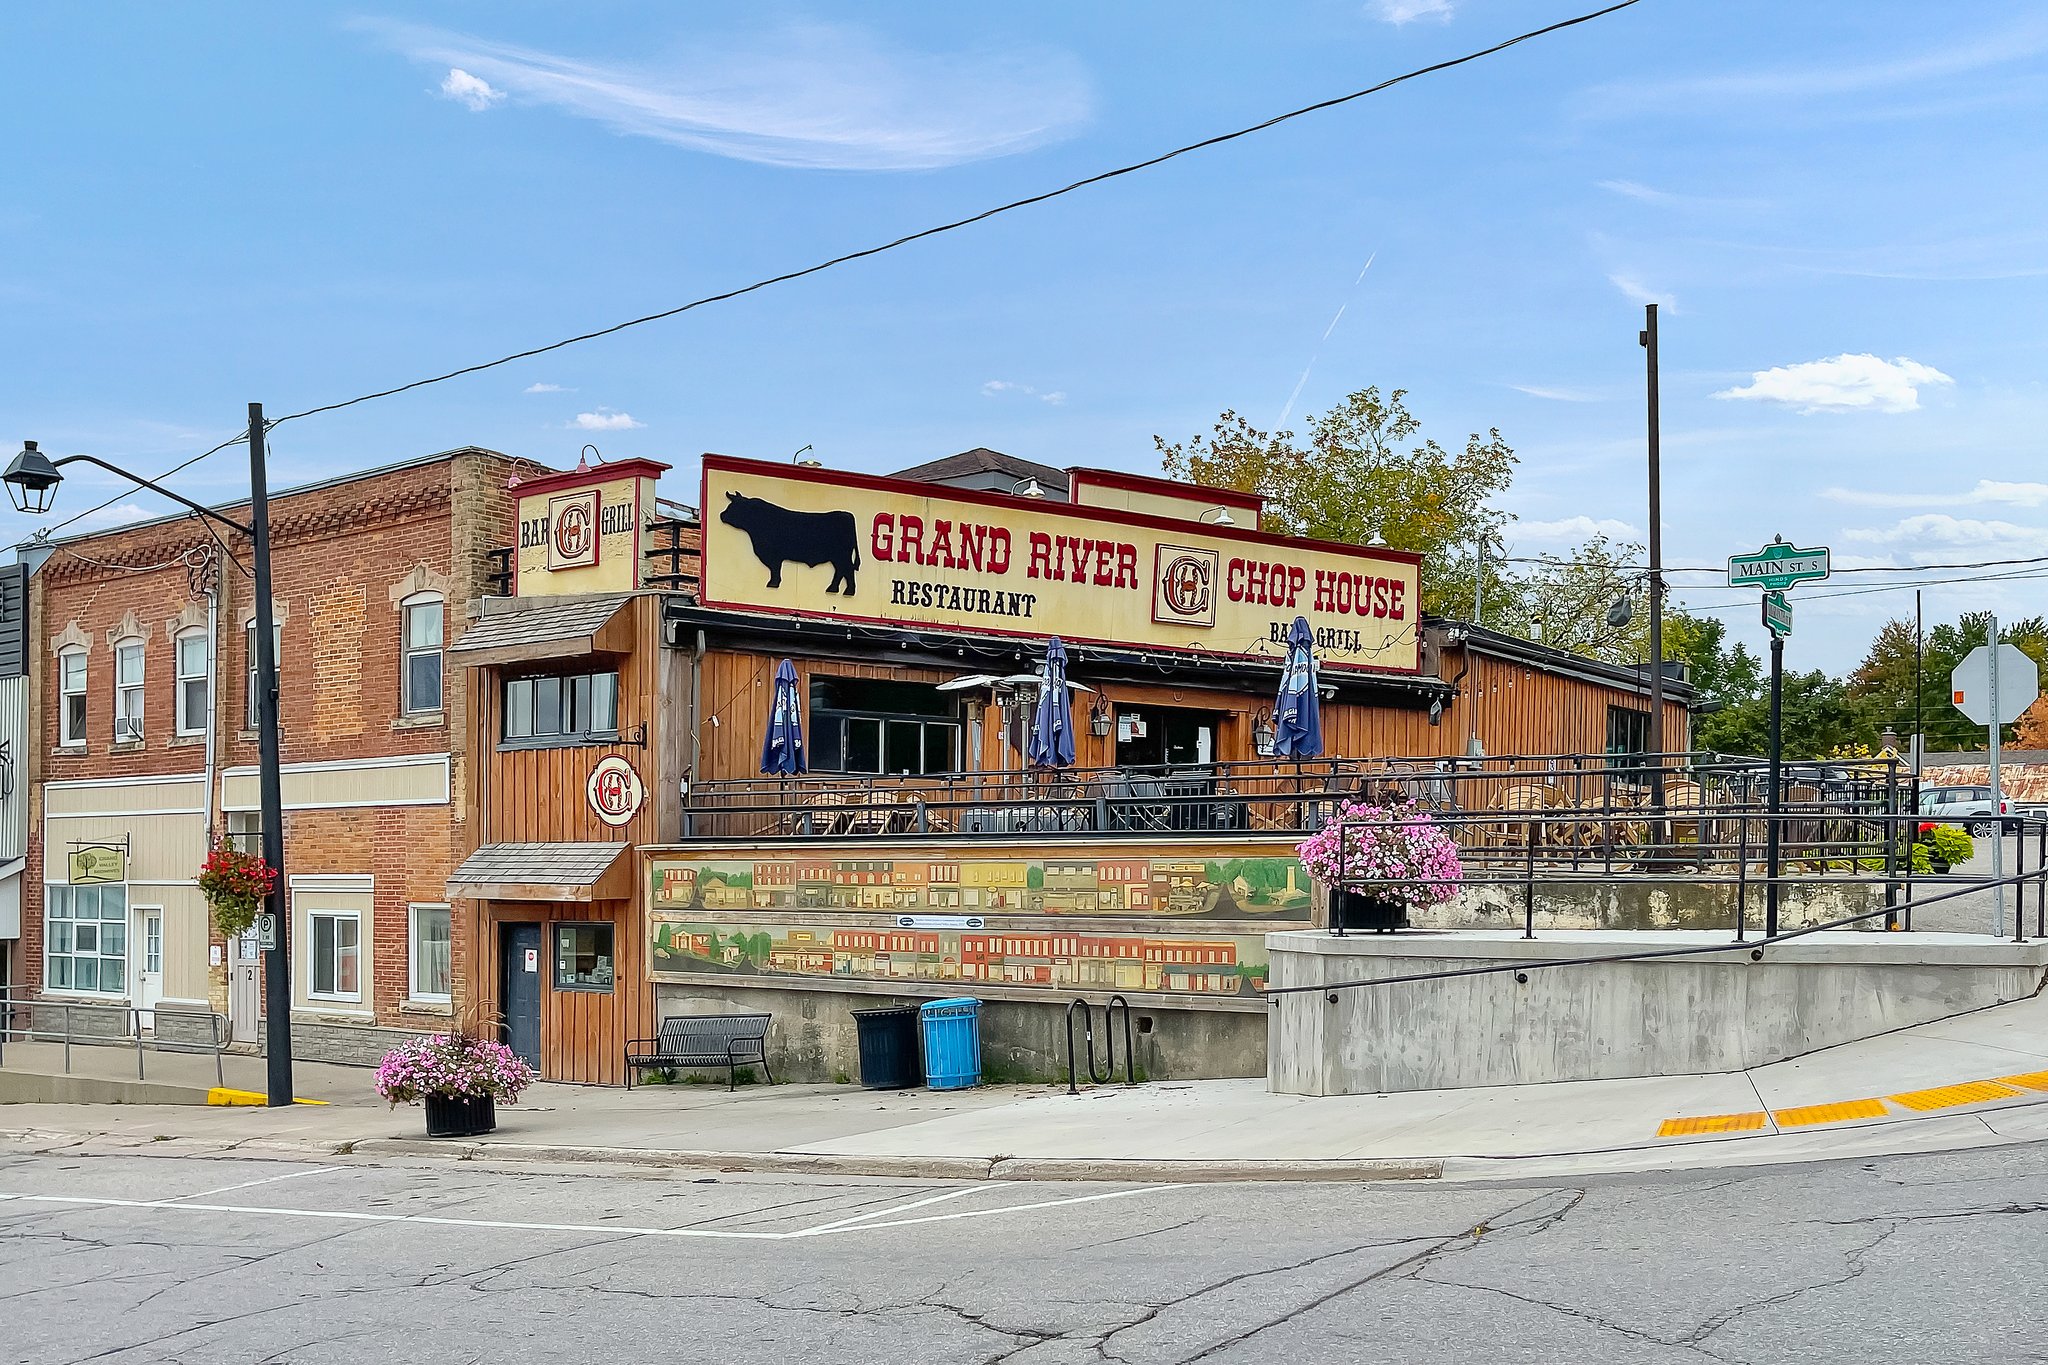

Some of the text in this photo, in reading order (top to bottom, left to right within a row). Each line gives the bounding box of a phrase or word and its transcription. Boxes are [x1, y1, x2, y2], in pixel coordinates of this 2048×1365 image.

[520, 503, 634, 548] BAR GRILL
[871, 512, 1138, 589] GRAND RIVER
[1740, 560, 1818, 577] MAIN ST. S
[890, 579, 1036, 618] RESTAURANT
[1227, 557, 1405, 621] CHOP HOUSE
[1269, 622, 1362, 651] BA GRILL
[247, 969, 253, 981] 2
